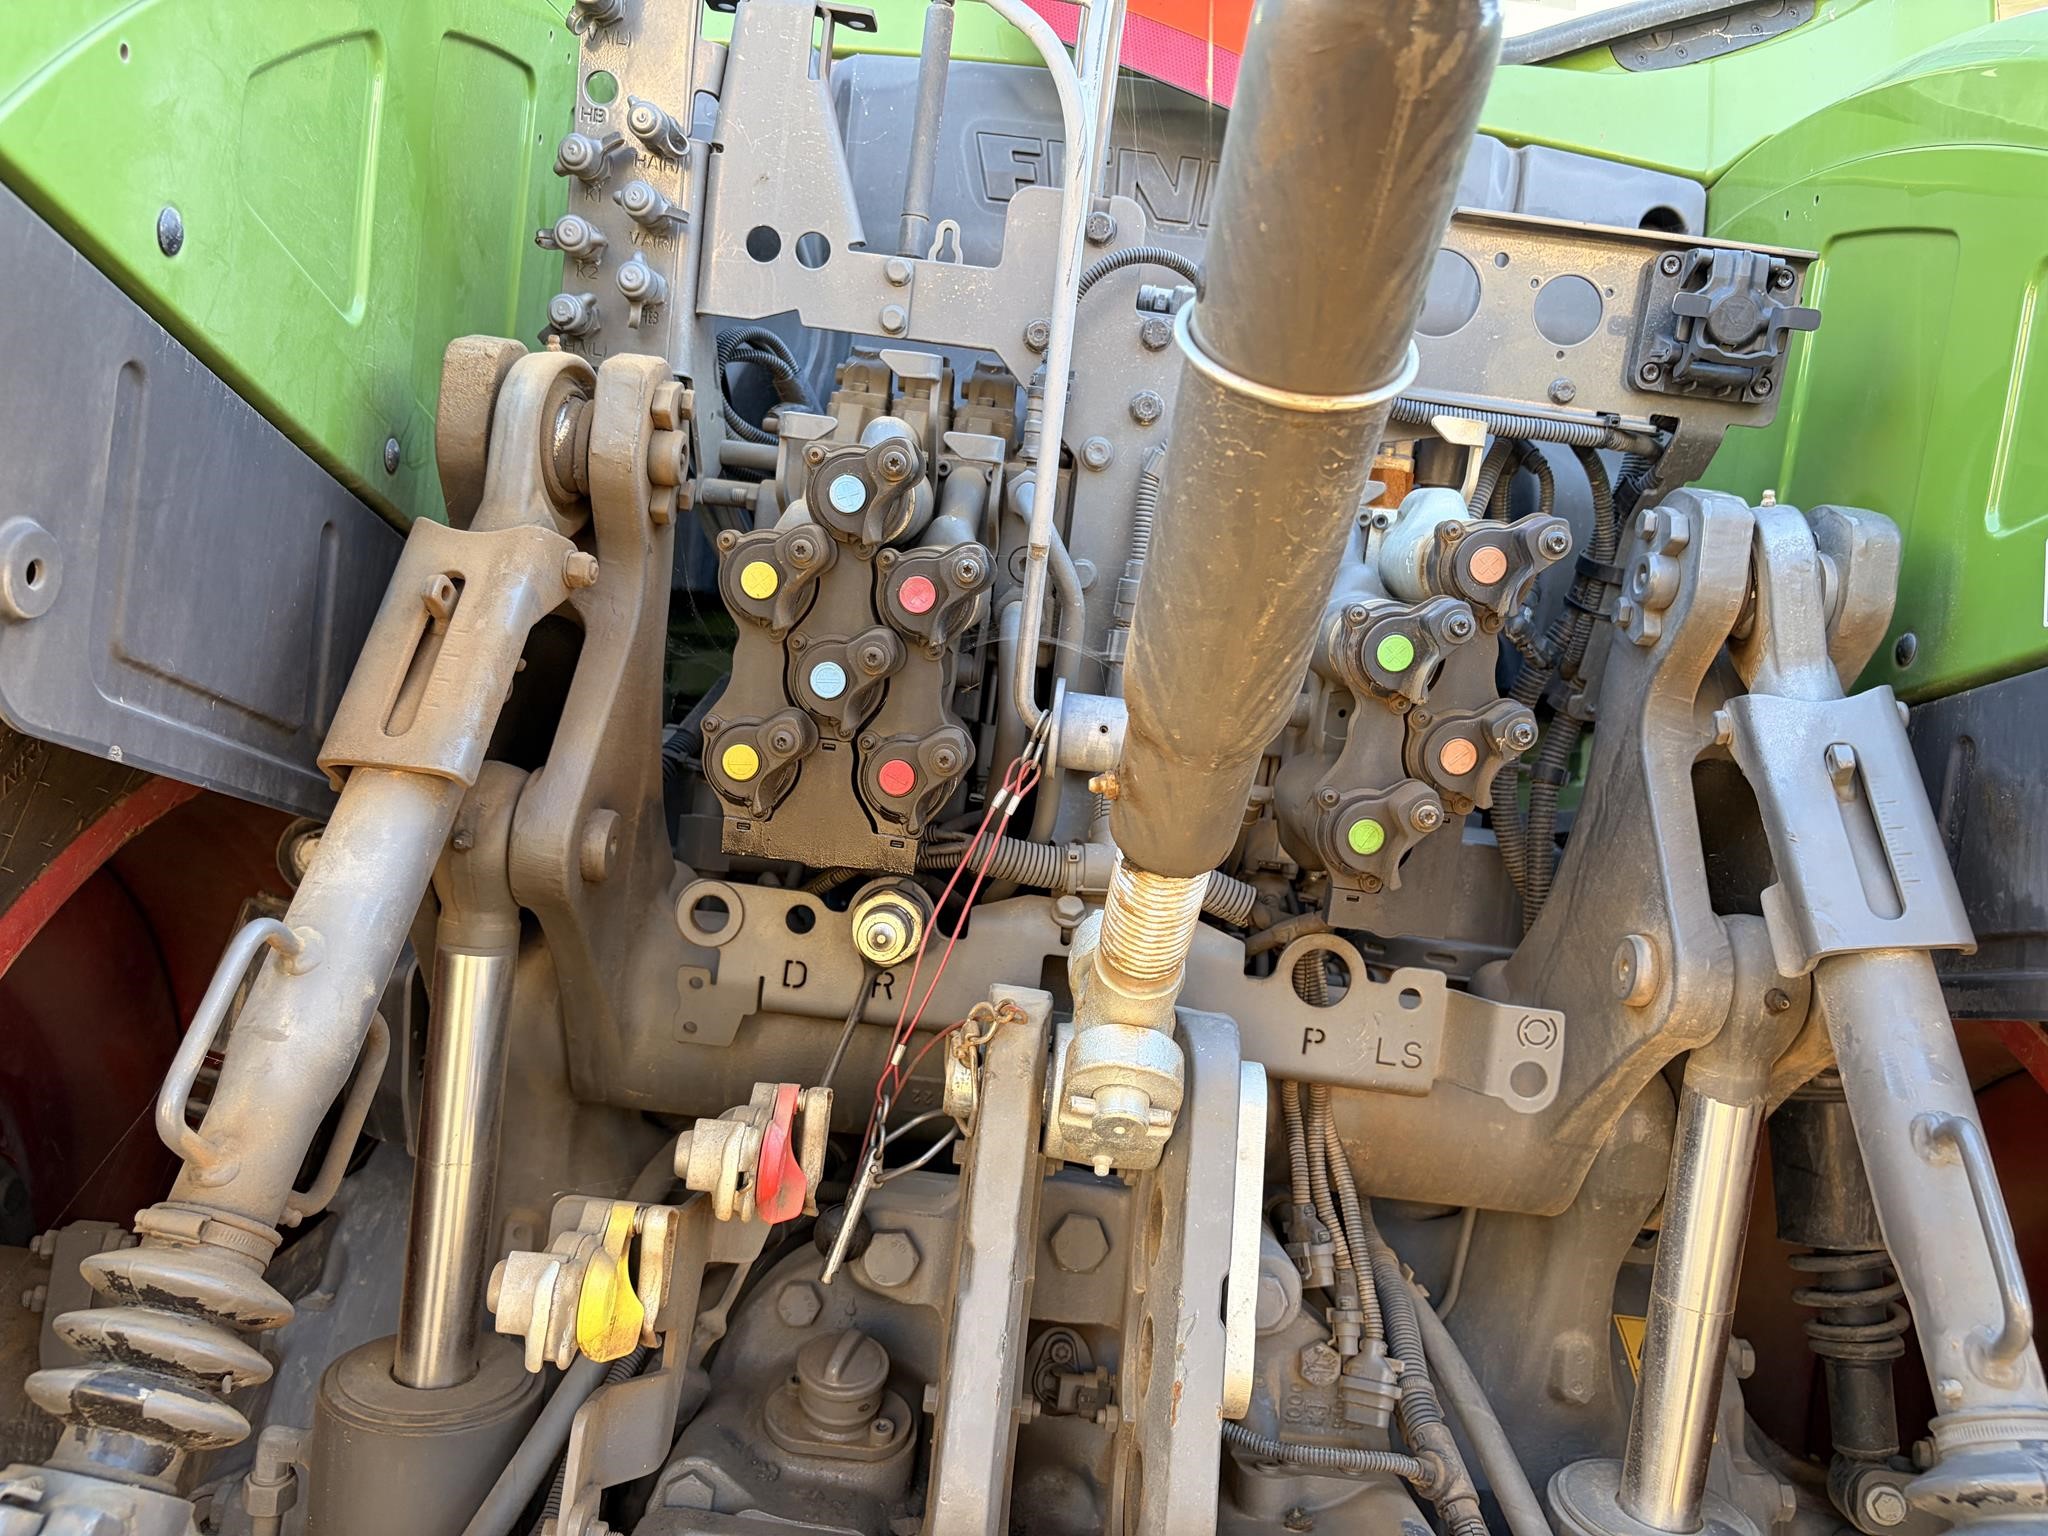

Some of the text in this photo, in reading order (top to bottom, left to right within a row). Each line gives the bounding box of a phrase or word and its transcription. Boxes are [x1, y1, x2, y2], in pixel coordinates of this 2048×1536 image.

[580, 106, 607, 123] HB
[634, 152, 680, 173] HA(R)
[584, 185, 602, 203] K1
[629, 231, 674, 251] VA(R)
[576, 263, 600, 280] K2
[782, 959, 808, 989] D
[871, 971, 896, 1000] R
[1301, 1026, 1326, 1055] P
[1375, 1037, 1423, 1069] LS
